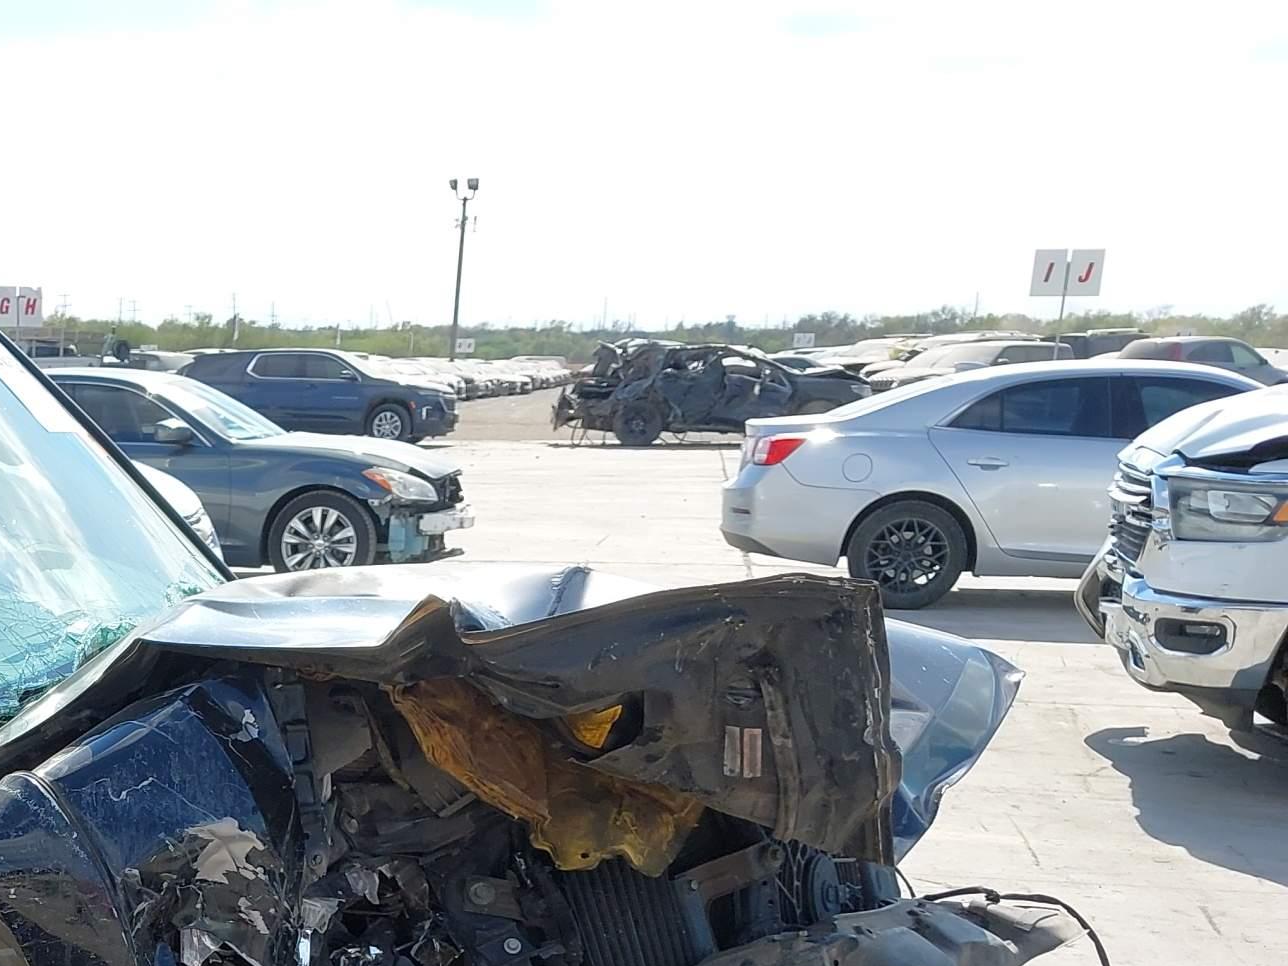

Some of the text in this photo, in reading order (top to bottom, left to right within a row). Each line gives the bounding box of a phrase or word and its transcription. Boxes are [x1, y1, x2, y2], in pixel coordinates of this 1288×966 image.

[1043, 262, 1095, 283] I J
[0, 297, 37, 316] G H
